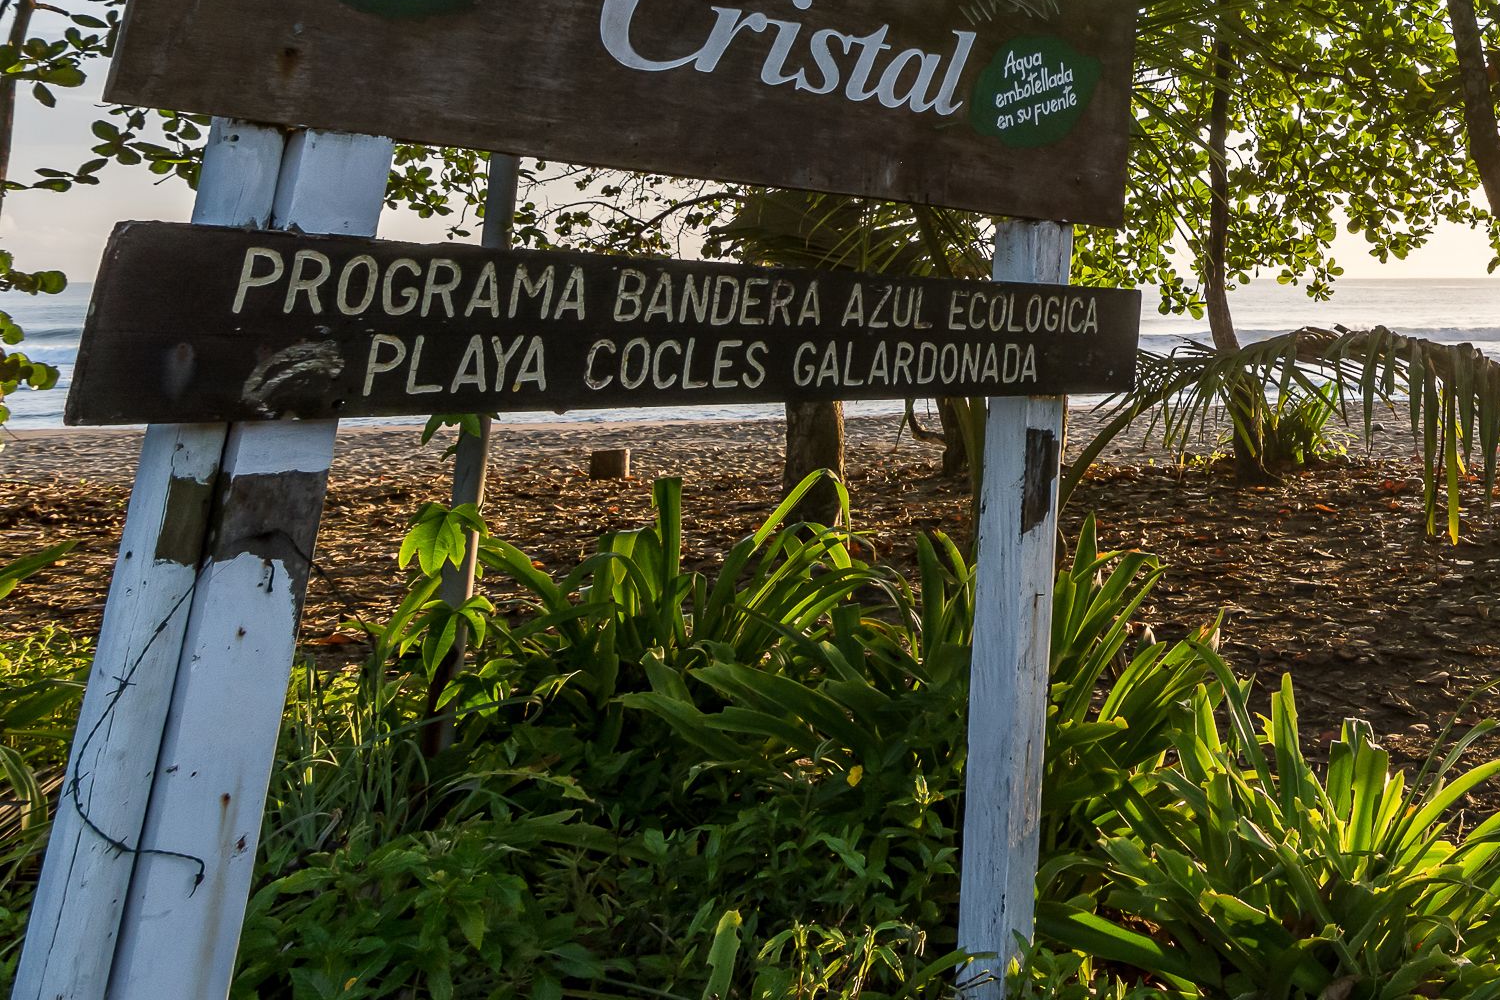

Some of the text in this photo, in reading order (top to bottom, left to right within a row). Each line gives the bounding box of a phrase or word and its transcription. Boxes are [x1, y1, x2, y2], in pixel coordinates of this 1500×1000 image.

[995, 61, 1074, 108] embotellada
[1004, 50, 1042, 80] Agua
[996, 114, 1014, 129] en
[1017, 105, 1031, 123] su
[232, 246, 1099, 335] PROGRAMA BANDERA AZUL ECOLOGICA
[362, 333, 1038, 397] PLAYA COCLES GALARDONADA
